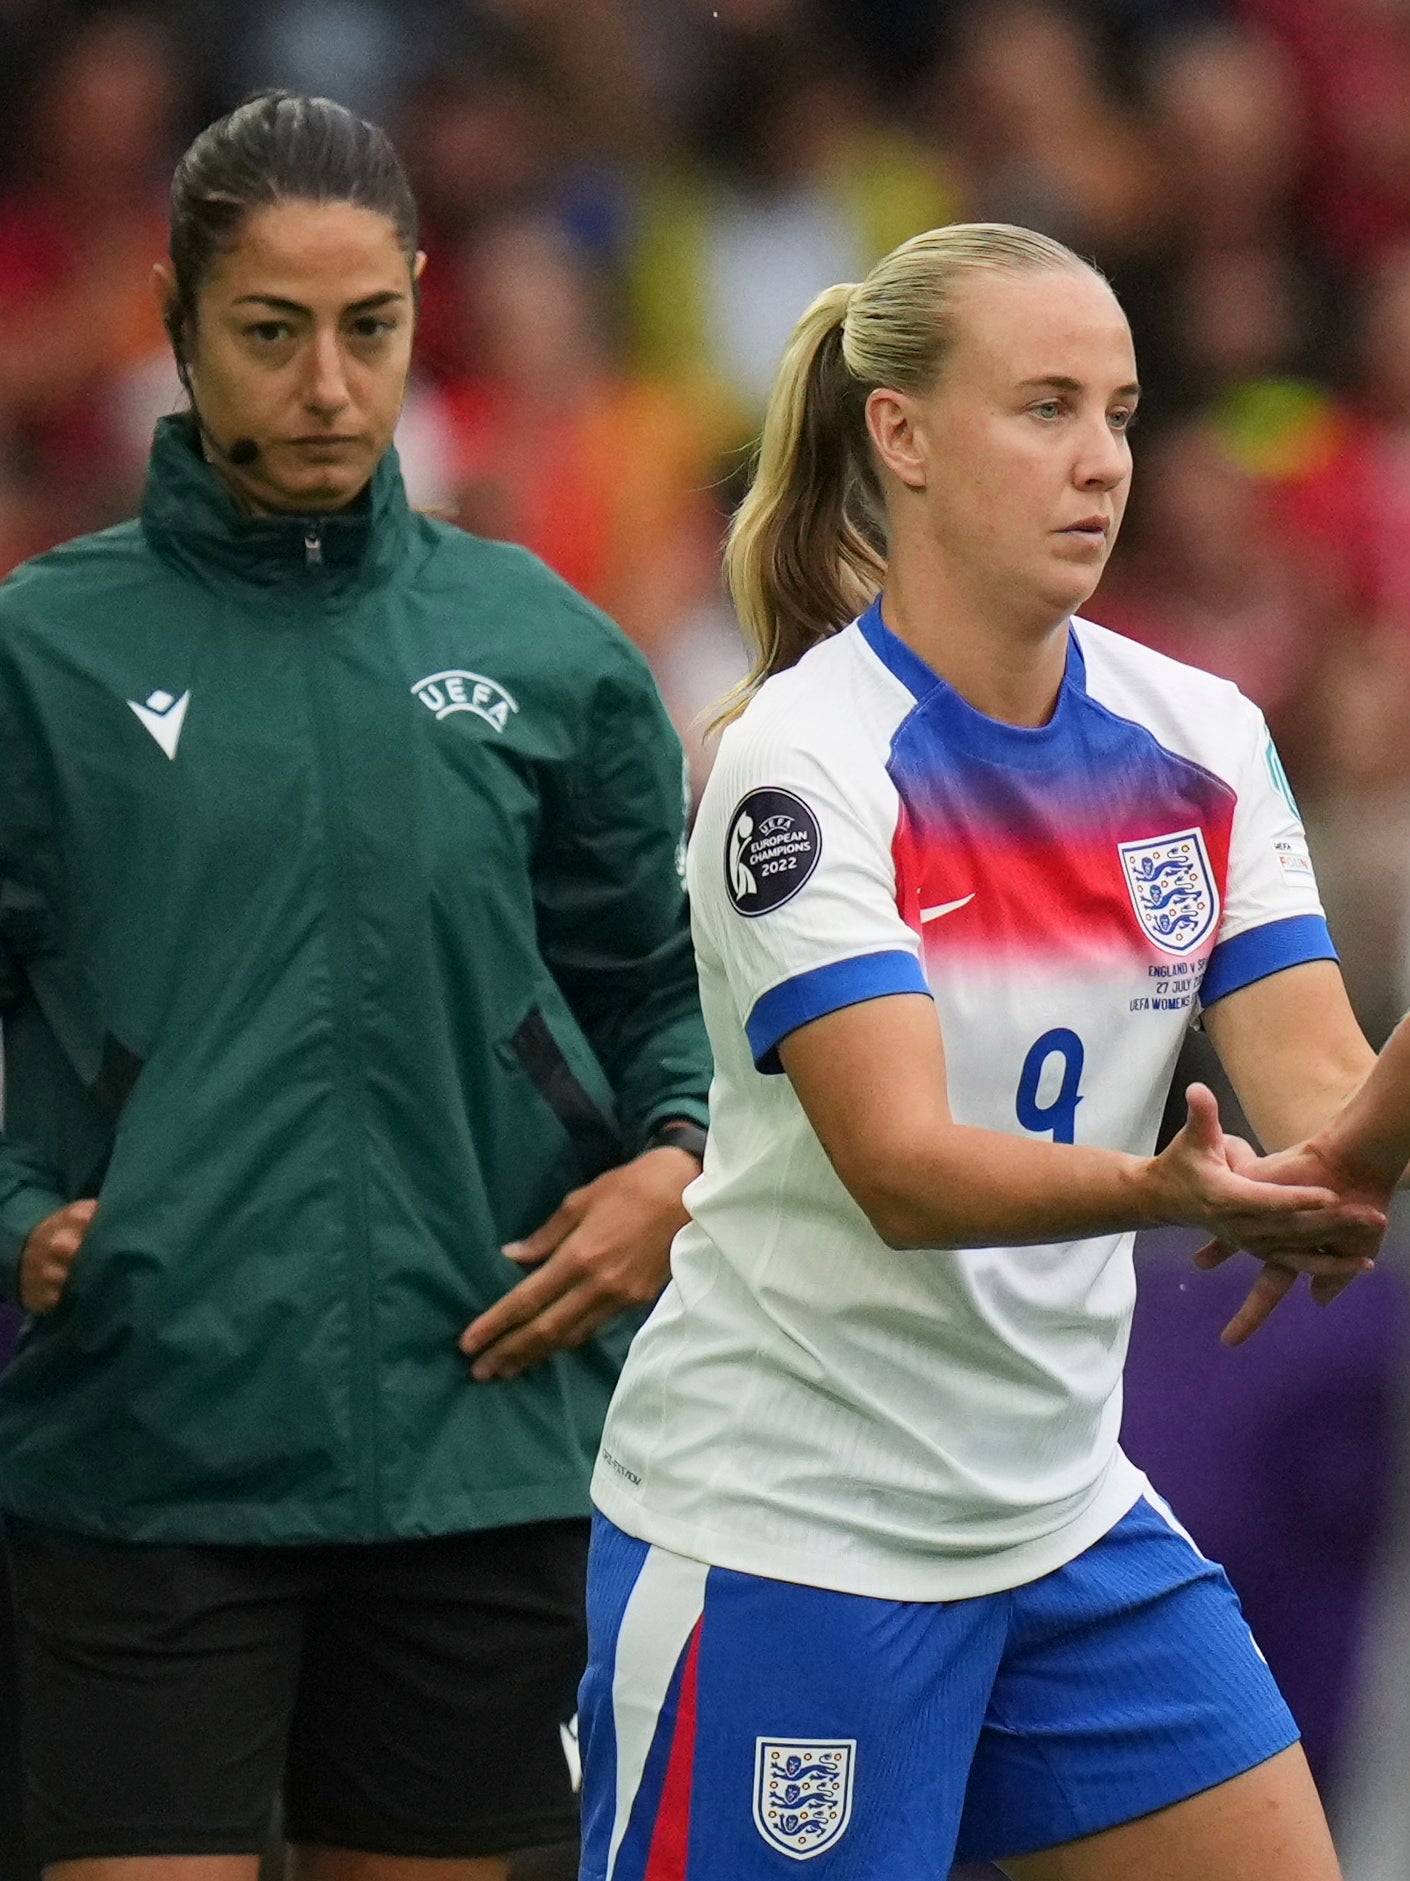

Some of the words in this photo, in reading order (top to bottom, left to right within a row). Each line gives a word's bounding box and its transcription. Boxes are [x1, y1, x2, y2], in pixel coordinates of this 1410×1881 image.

[418, 677, 510, 727] UEFA
[759, 818, 793, 834] UEFA
[749, 841, 811, 865] CHAMPIONS
[750, 831, 808, 854] EUROPEAN
[761, 856, 798, 878] 2022
[1148, 962, 1188, 978] ENGLAND
[1156, 981, 1169, 995] 27
[1171, 979, 1192, 994] JULY
[1129, 997, 1150, 1012] UEFA
[1015, 1026, 1085, 1145] 9
